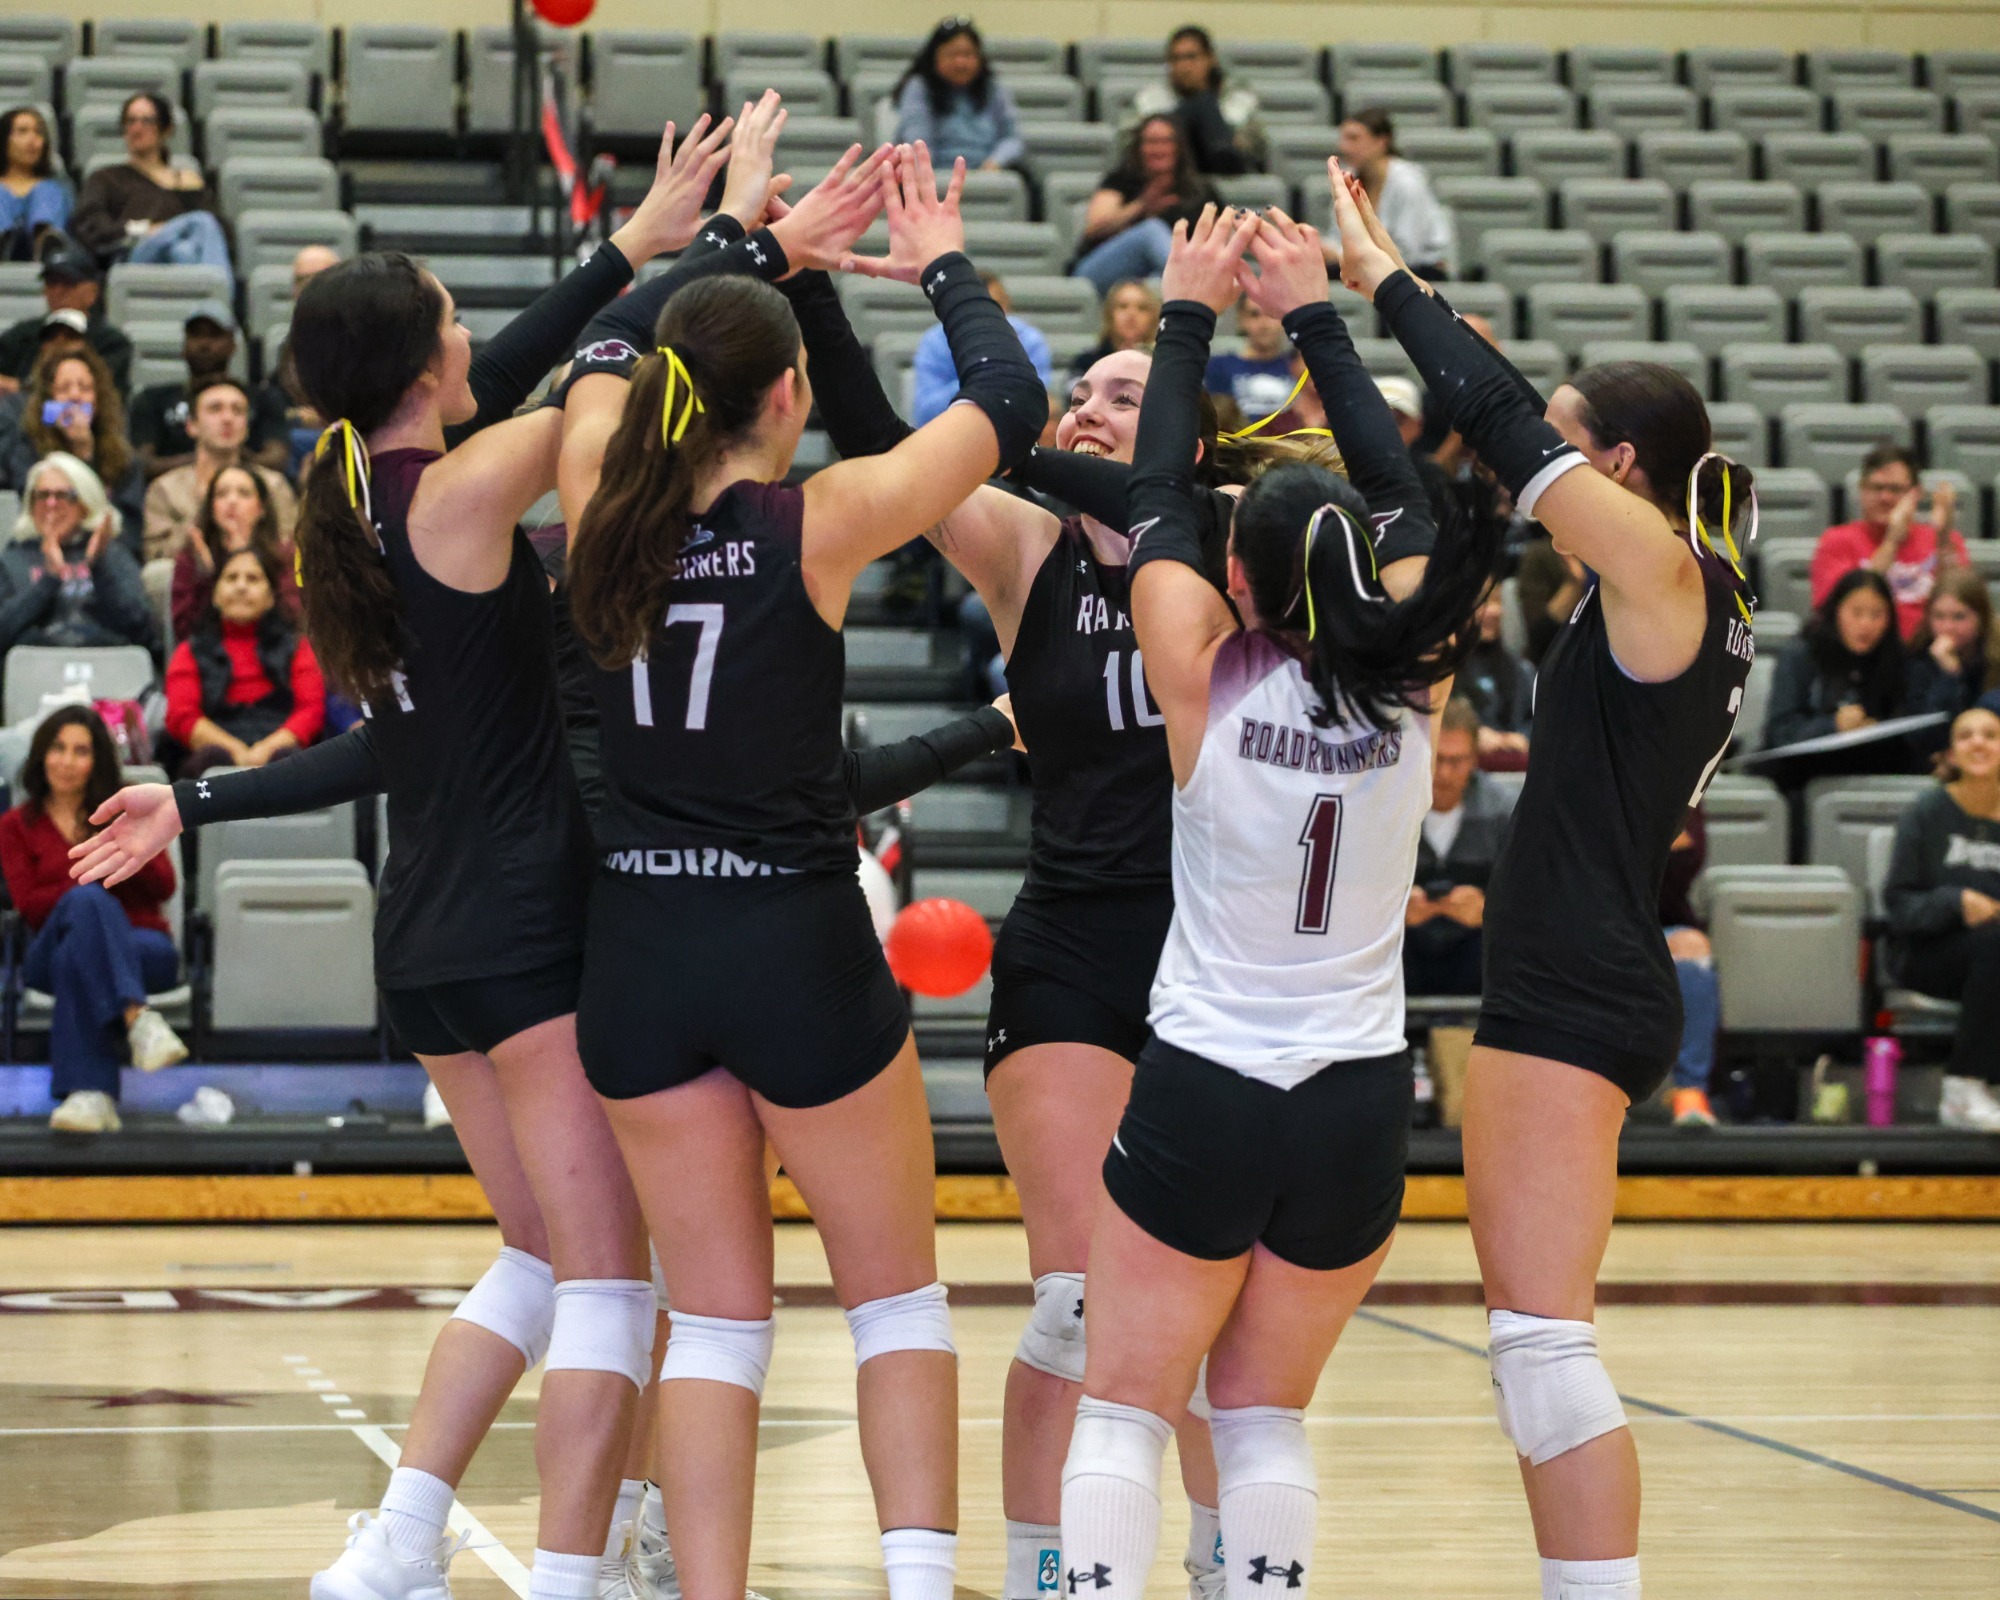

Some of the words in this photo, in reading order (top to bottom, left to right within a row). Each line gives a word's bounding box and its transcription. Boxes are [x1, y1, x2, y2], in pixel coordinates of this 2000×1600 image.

[631, 603, 724, 730] 17
[1238, 716, 1402, 775] ROADRUNNERS
[1294, 792, 1344, 936] 1
